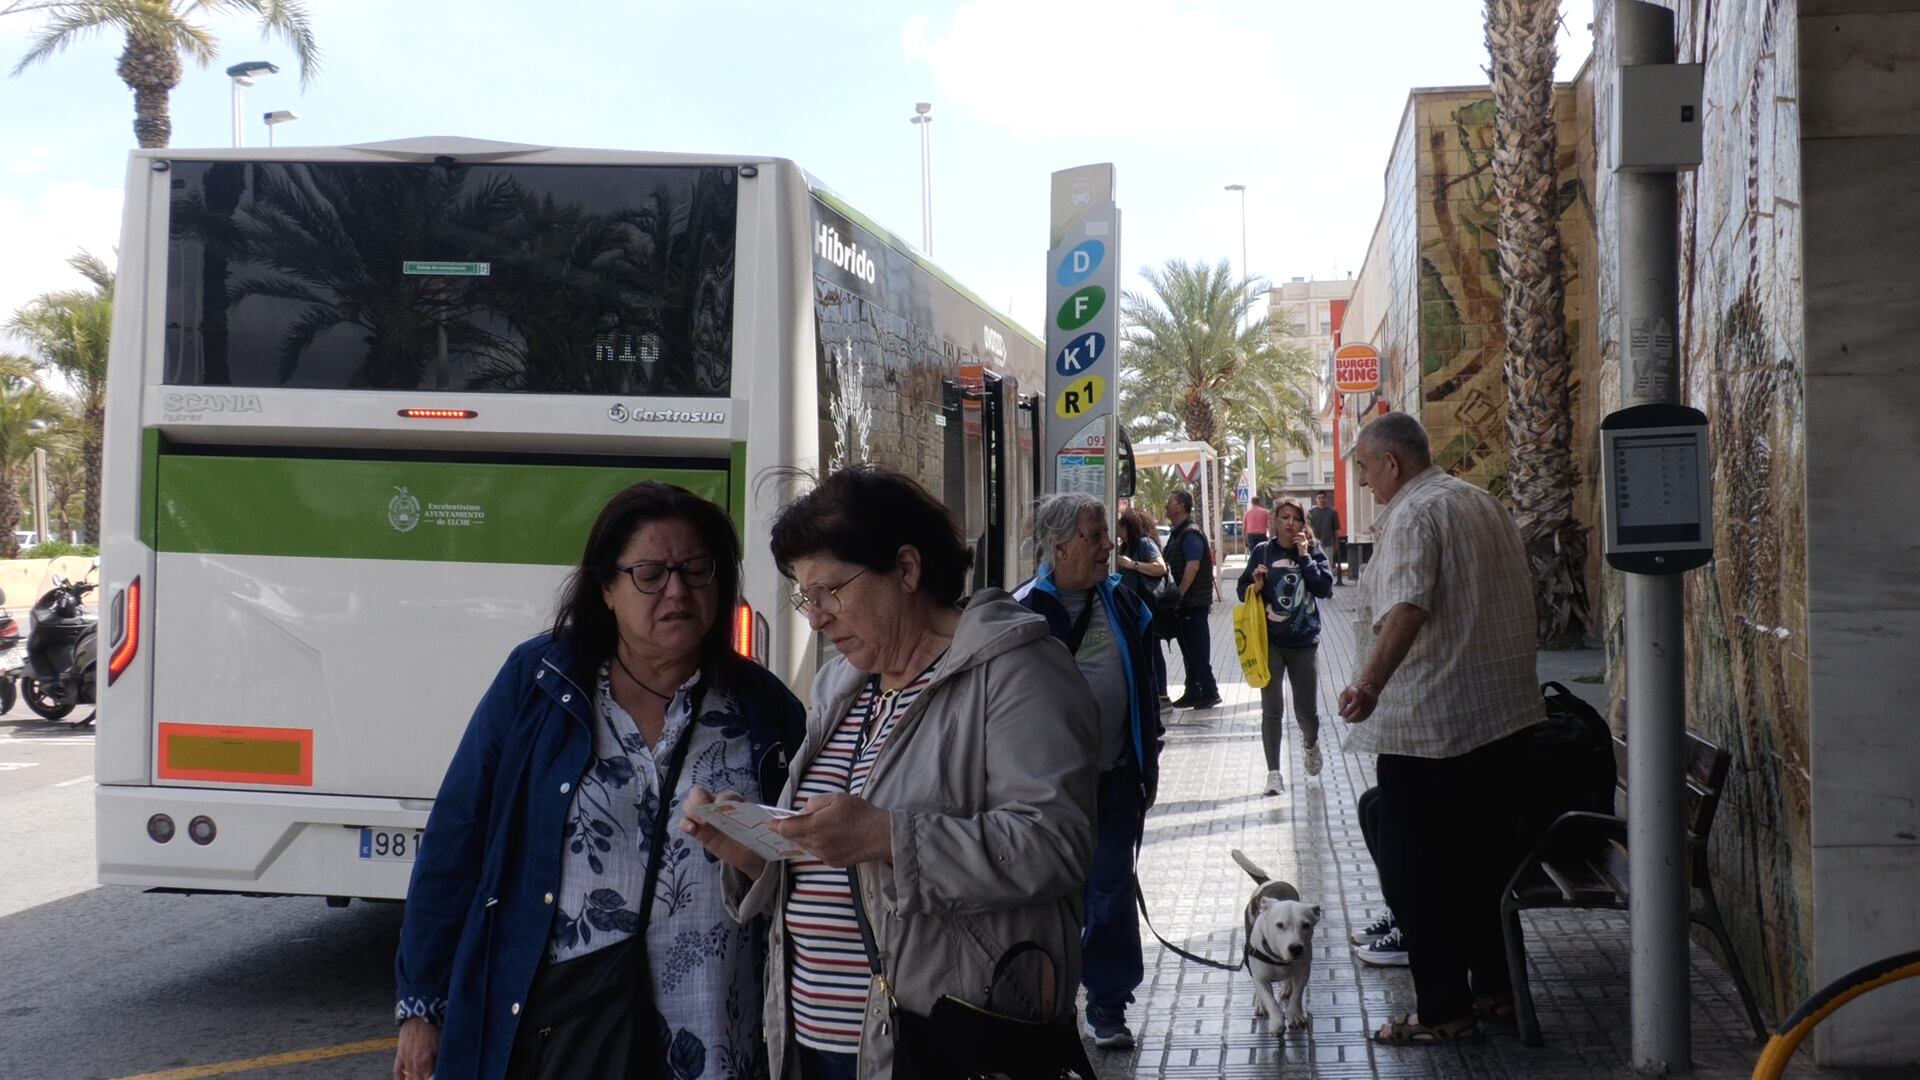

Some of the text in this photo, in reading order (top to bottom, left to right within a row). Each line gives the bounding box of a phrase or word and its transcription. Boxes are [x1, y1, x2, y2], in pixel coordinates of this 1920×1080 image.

[815, 220, 875, 284] Híbrido
[1073, 250, 1090, 272] D
[1075, 296, 1089, 319] F
[1064, 335, 1097, 370] K1
[1336, 359, 1378, 369] BURGER
[1336, 369, 1378, 382] KING
[164, 394, 263, 413] SCANIA
[1065, 381, 1093, 413] R1
[632, 408, 725, 424] Castrosua
[424, 511, 485, 519] AYUNTAMIENTO
[436, 518, 471, 526] de ELCHE
[375, 831, 420, 857] 981
